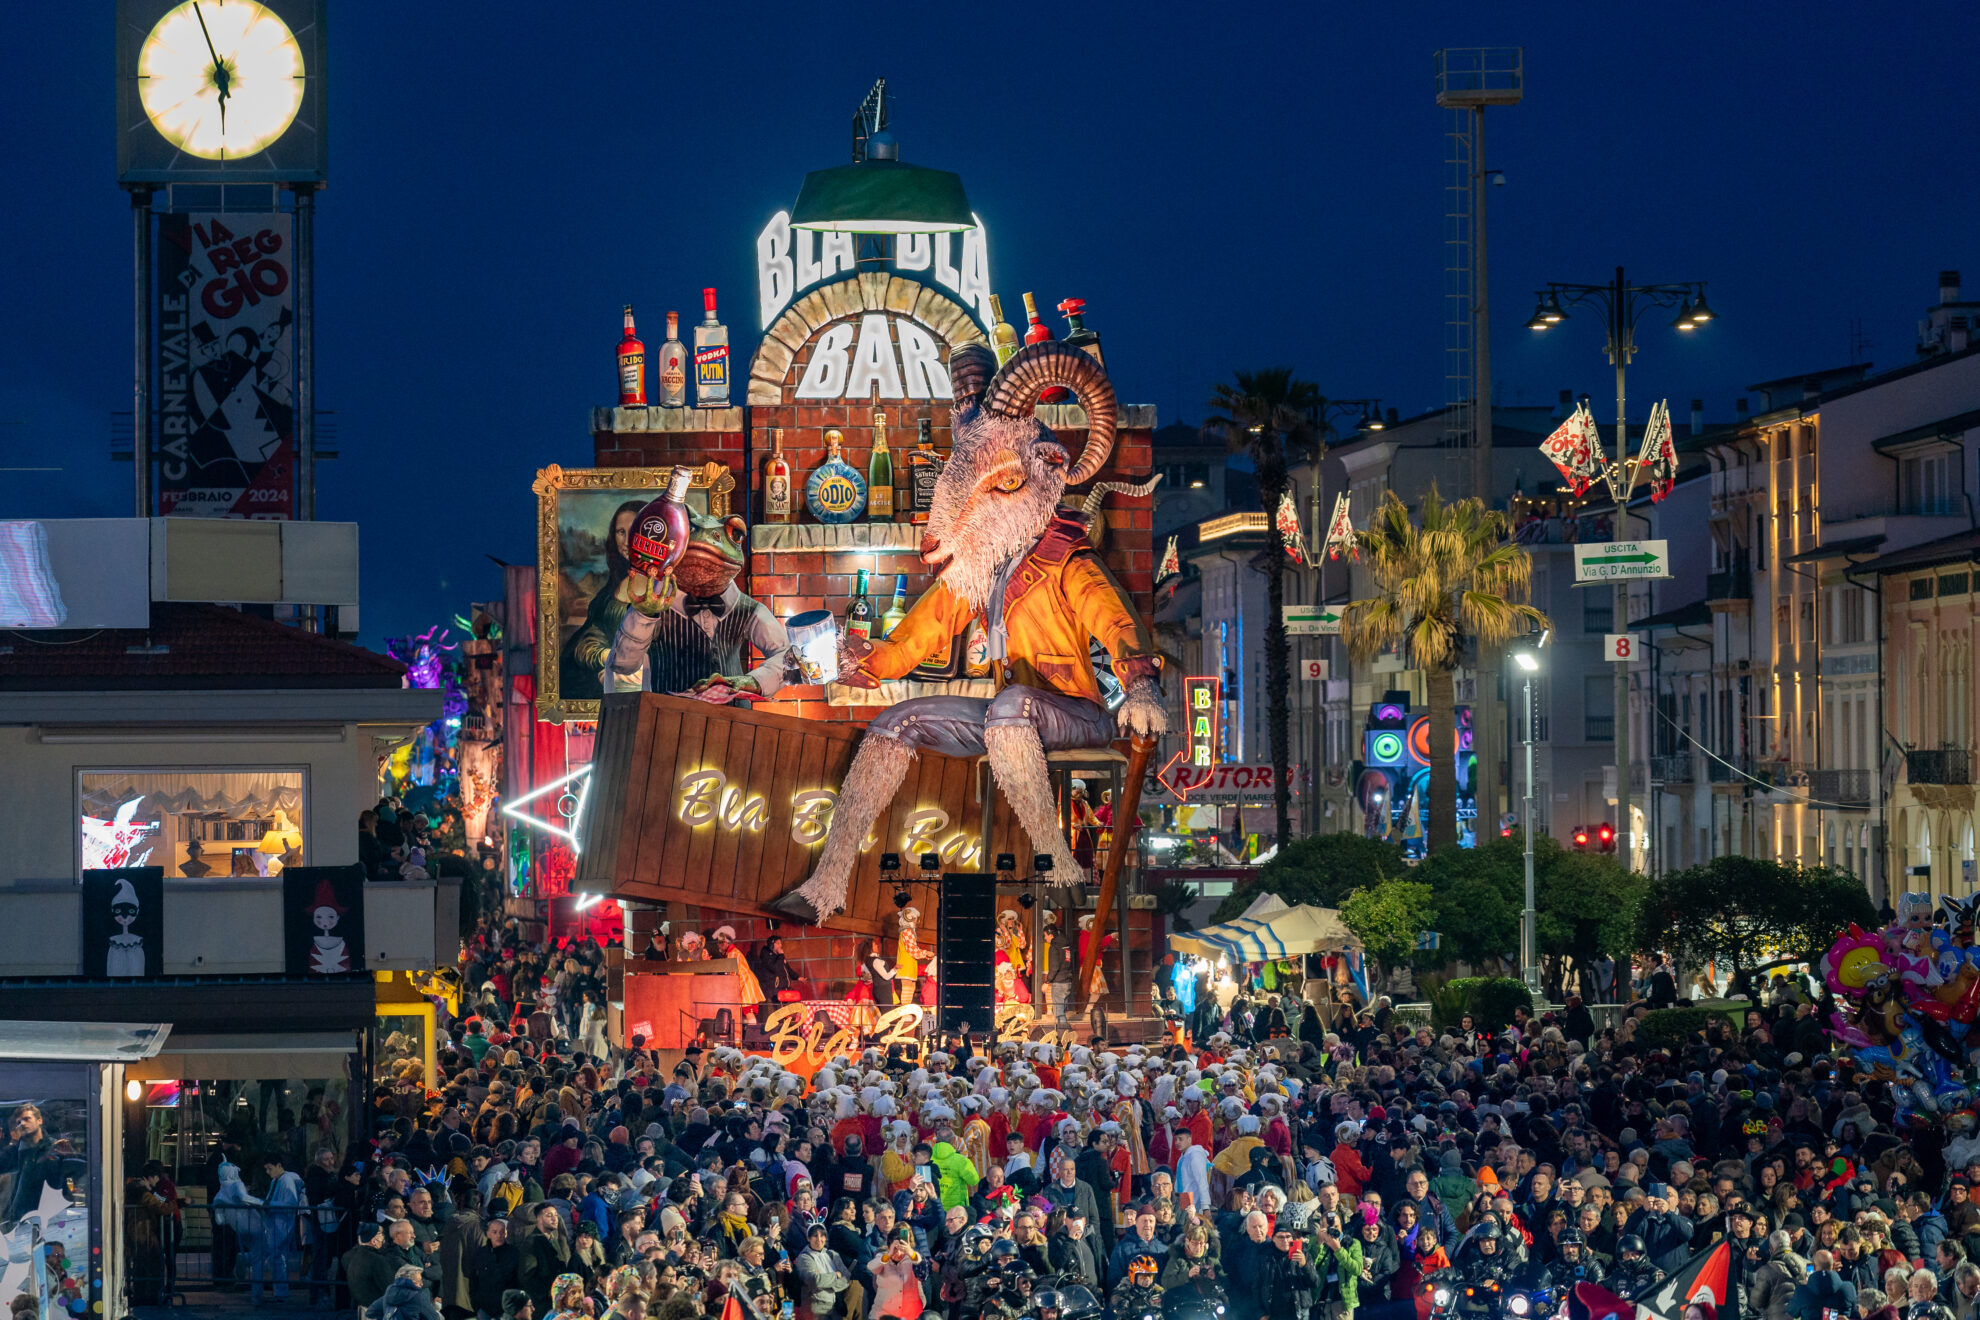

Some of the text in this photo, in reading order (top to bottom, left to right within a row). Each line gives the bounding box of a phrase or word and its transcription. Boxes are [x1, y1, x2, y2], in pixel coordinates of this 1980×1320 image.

[164, 218, 234, 256] VIA
[207, 229, 283, 275] REG
[201, 258, 289, 319] GIO
[696, 348, 727, 363] VODKA
[795, 314, 954, 399] BAR
[700, 363, 724, 380] PUTIN
[162, 293, 187, 481] CARNEVALE
[162, 488, 289, 502] FEBBRAIO 2024
[821, 484, 853, 505] ODIO
[1604, 544, 1638, 554] USCITA
[1582, 564, 1662, 577] Via G. D'Annunzio
[1616, 638, 1631, 658] 8
[1309, 662, 1322, 678] 9
[1193, 688, 1212, 766] BAR
[679, 769, 770, 833] Bla
[1244, 793, 1277, 801] VIAREG
[765, 1002, 857, 1067] Bla
